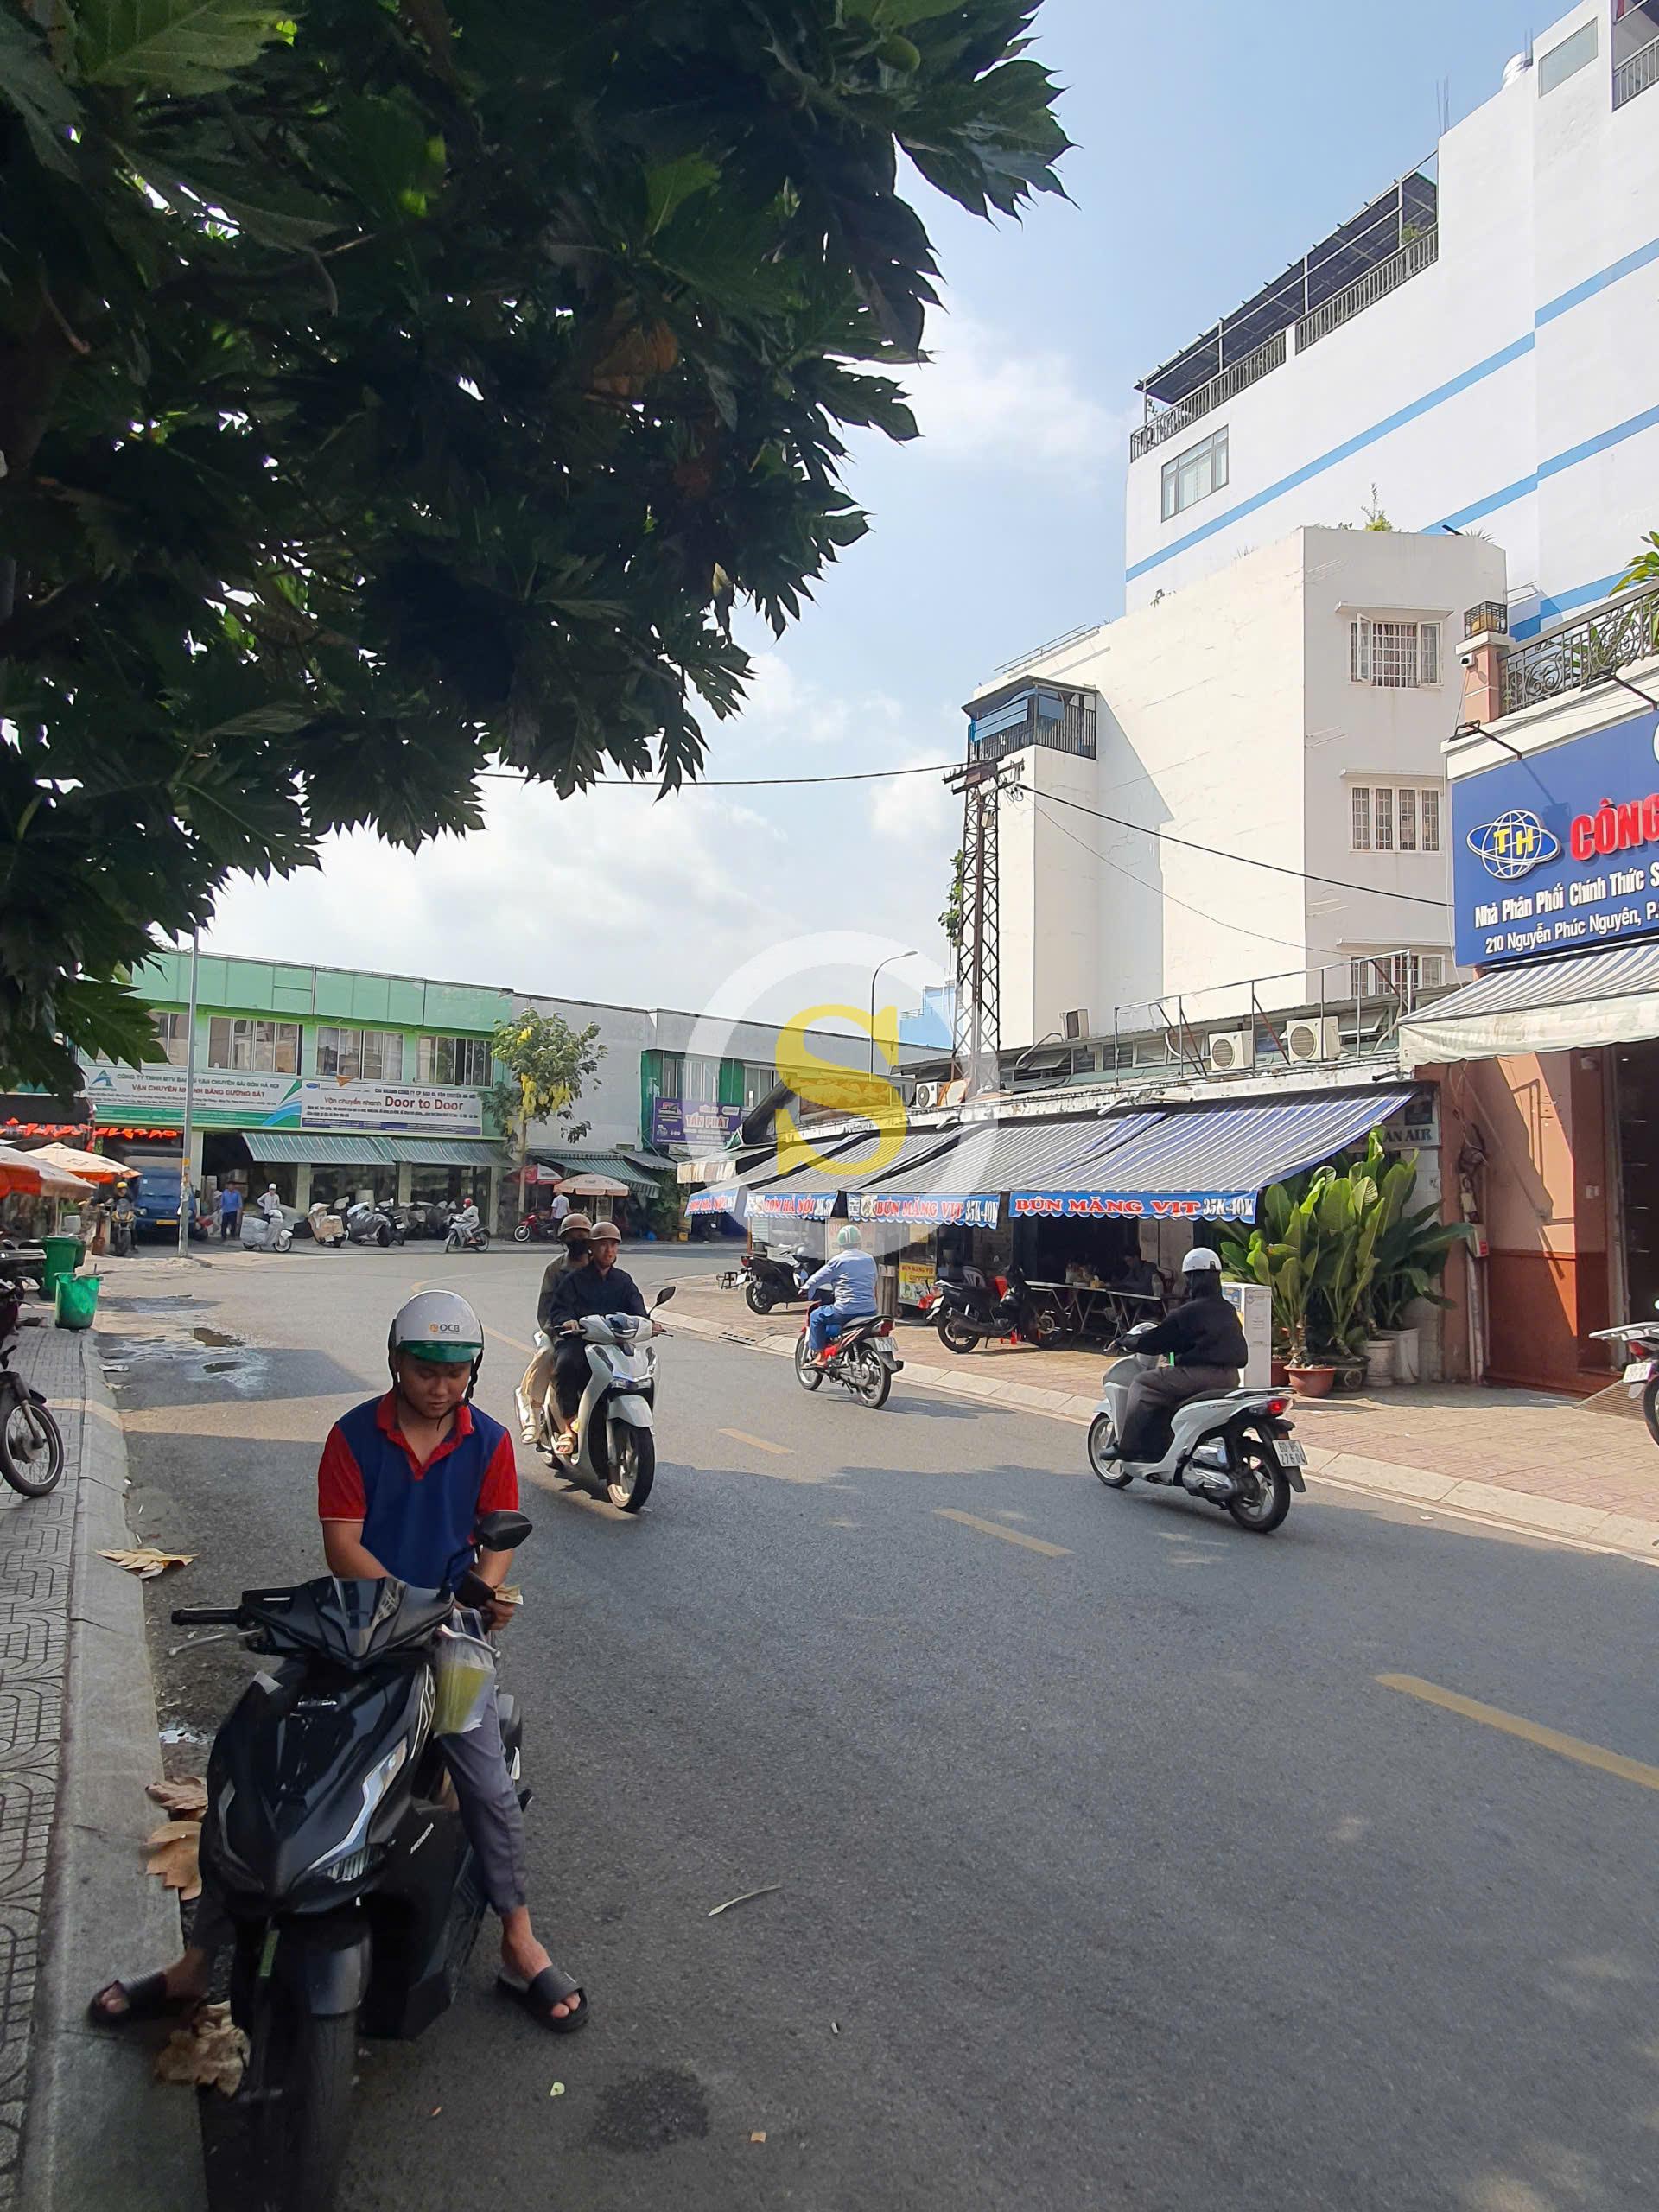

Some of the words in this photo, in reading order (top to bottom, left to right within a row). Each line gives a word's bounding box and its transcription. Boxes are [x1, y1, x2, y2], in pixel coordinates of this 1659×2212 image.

[1569, 794, 1659, 861] CÔNG
[1493, 828, 1535, 855] TH
[1475, 902, 1498, 929] Nhà
[1502, 895, 1533, 923] Phân
[1535, 883, 1564, 915] Phối
[1569, 876, 1607, 907] Chính
[1609, 867, 1646, 896] Thức
[1485, 935, 1504, 955] 210
[1507, 923, 1552, 952] Nguyễn
[1554, 918, 1586, 939] Phúc
[1589, 908, 1642, 935] Nguyên,
[385, 1096, 415, 1109] Door
[418, 1098, 430, 1109] to
[434, 1098, 463, 1111] Door
[902, 1196, 938, 1219] MĂNG
[941, 1199, 964, 1222] VỊT
[1015, 1196, 1063, 1211] BÚN
[1068, 1196, 1143, 1216] MĂNG
[1150, 1199, 1201, 1217] VỊT
